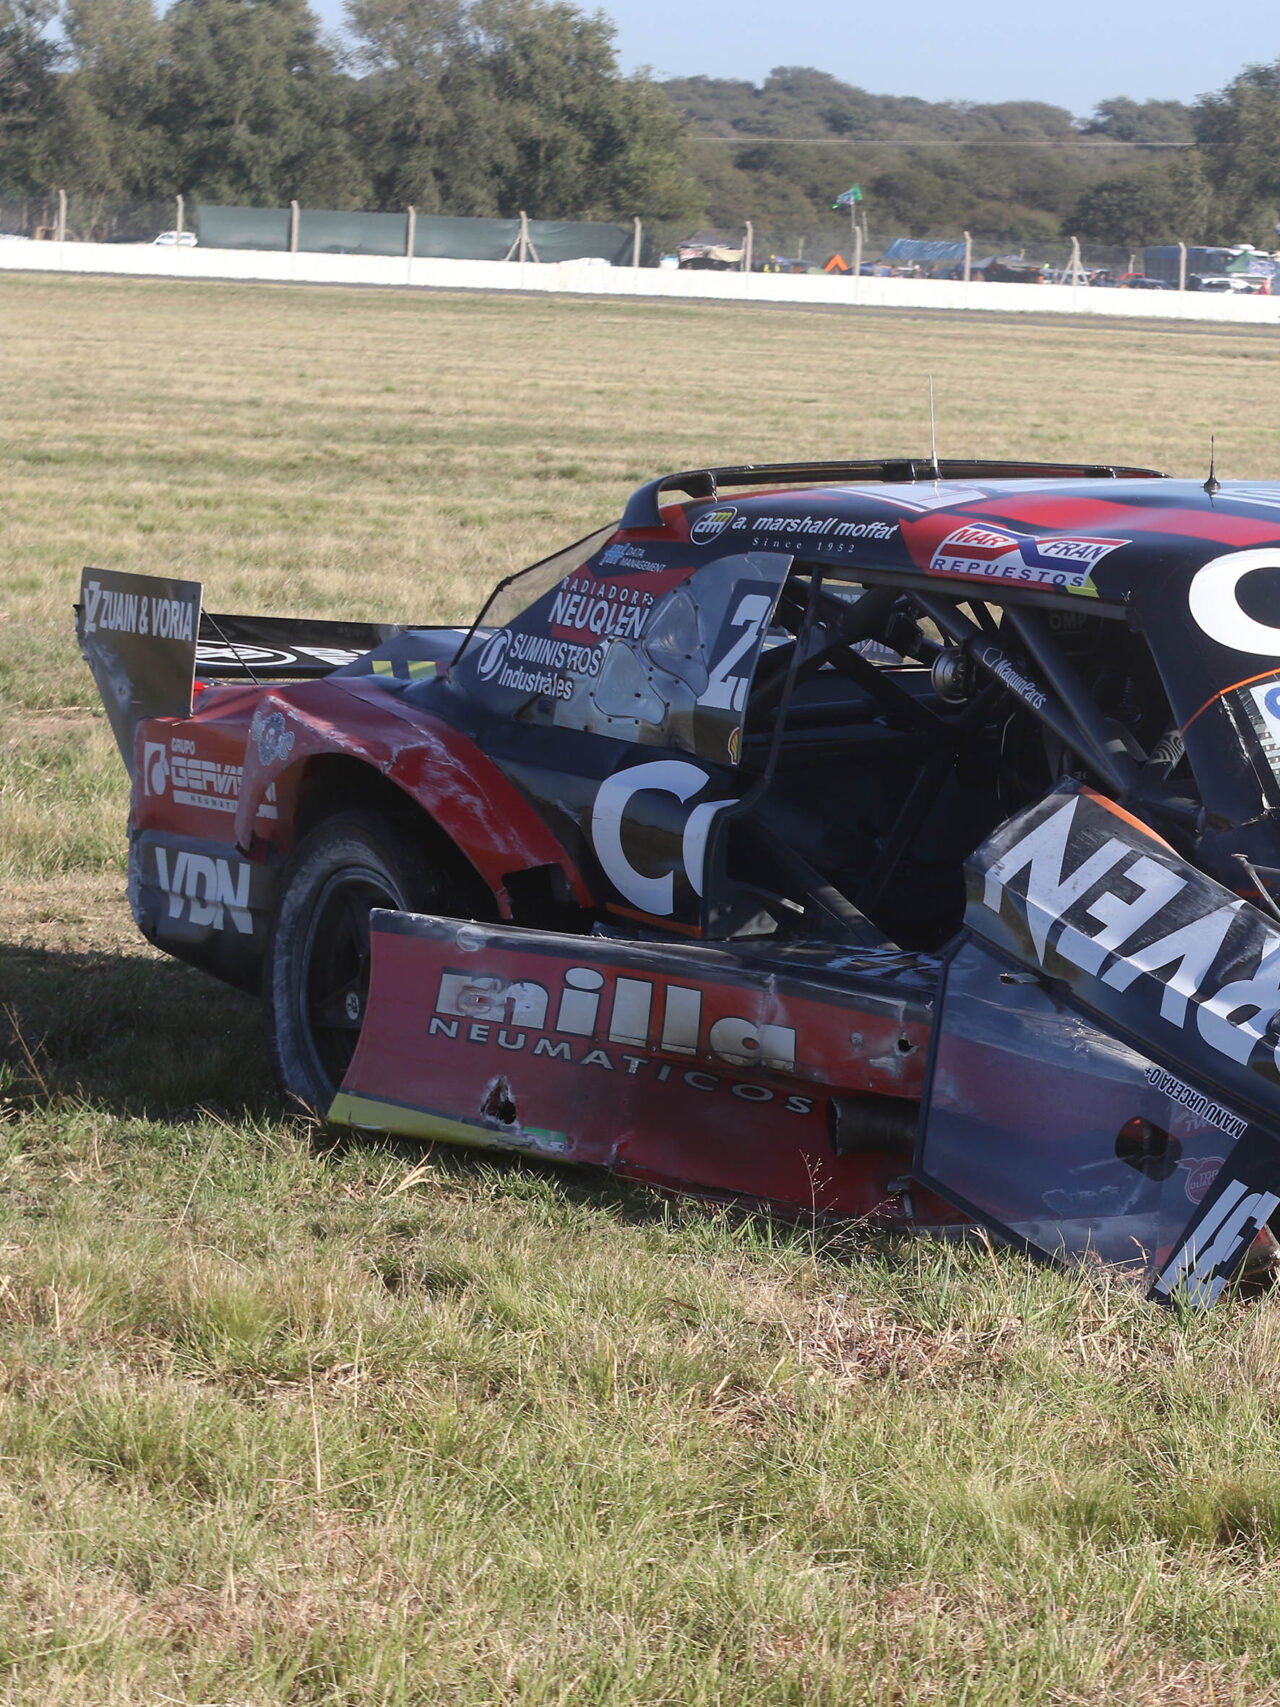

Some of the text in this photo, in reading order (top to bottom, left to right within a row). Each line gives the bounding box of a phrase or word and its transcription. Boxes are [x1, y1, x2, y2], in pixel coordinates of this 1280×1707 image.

[731, 515, 900, 540] a. marshall moffat
[949, 528, 1111, 560] MAR FRAN
[752, 537, 856, 553] Since 1952
[619, 557, 667, 574] MANAGEMENT
[932, 558, 1084, 587] REPUESTOS
[99, 590, 139, 634] ZUAIN
[139, 595, 149, 635] &
[152, 596, 193, 641] VORIA
[171, 738, 195, 755] GRUPO
[155, 847, 254, 935] VDN
[434, 967, 797, 1074] milla
[427, 1016, 814, 1115] NEUMATICOS
[1158, 1072, 1208, 1116] URCERA
[1202, 1103, 1248, 1140] MANU
